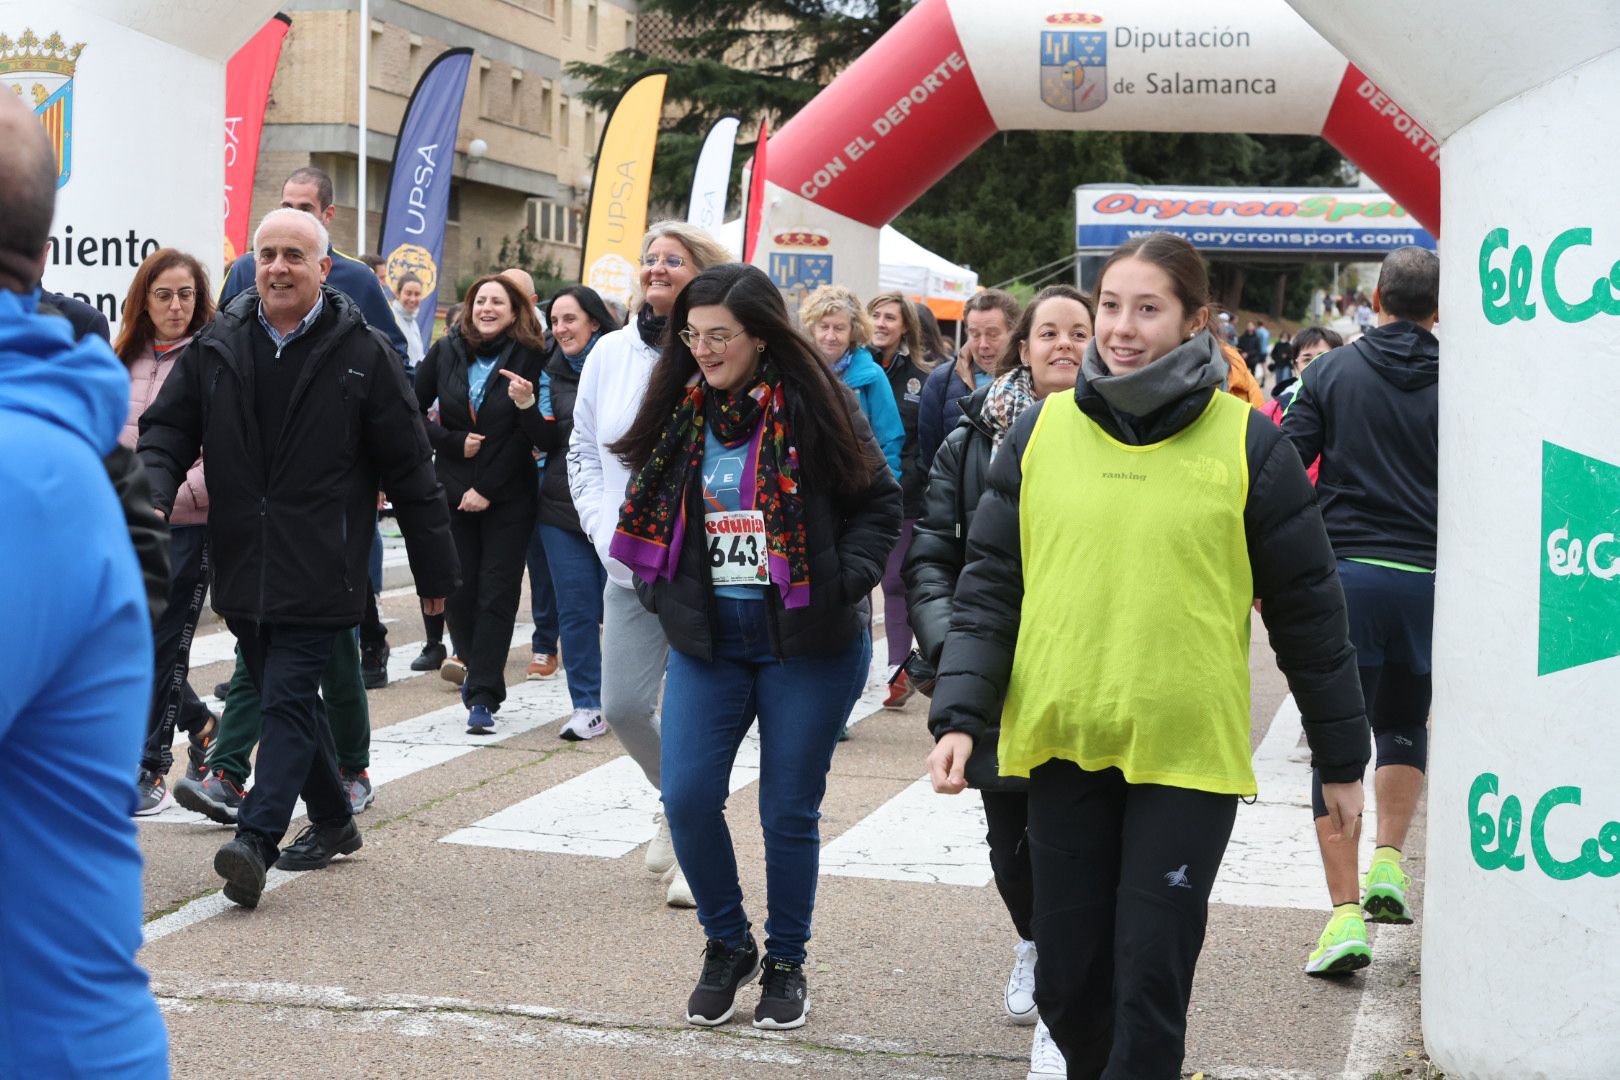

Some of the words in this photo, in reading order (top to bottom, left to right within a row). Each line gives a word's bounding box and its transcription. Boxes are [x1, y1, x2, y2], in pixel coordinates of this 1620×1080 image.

[1115, 25, 1250, 53] Diputación
[1113, 77, 1135, 94] de
[1146, 72, 1277, 95] Salamanca
[800, 156, 847, 199] CON
[843, 136, 876, 161] EL
[872, 51, 967, 138] DEPORTE
[405, 144, 438, 234] UPSA
[607, 160, 637, 244] UPSA
[1479, 227, 1536, 325] El
[1101, 471, 1147, 482] ranking
[708, 534, 759, 568] 643
[1547, 527, 1584, 577] El
[1586, 532, 1620, 580] C
[190, 583, 204, 611] LURE
[179, 623, 194, 651] LURE
[171, 663, 186, 692] LURE
[163, 704, 177, 732] LURE
[1468, 772, 1525, 871] El
